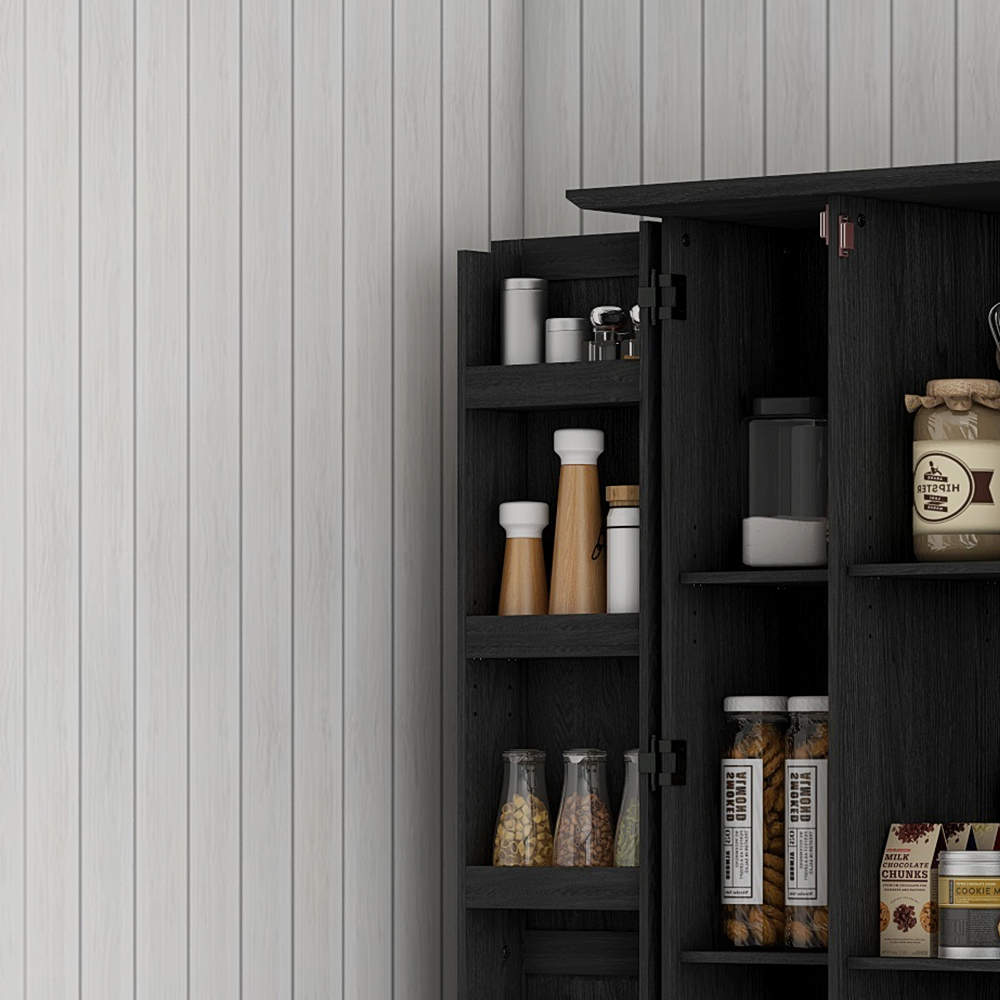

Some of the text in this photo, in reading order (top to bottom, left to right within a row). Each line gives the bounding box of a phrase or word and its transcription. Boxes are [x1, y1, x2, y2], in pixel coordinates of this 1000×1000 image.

[884, 853, 910, 861] MILK
[881, 869, 928, 879] CHUNKS
[956, 887, 991, 895] COOKIE
